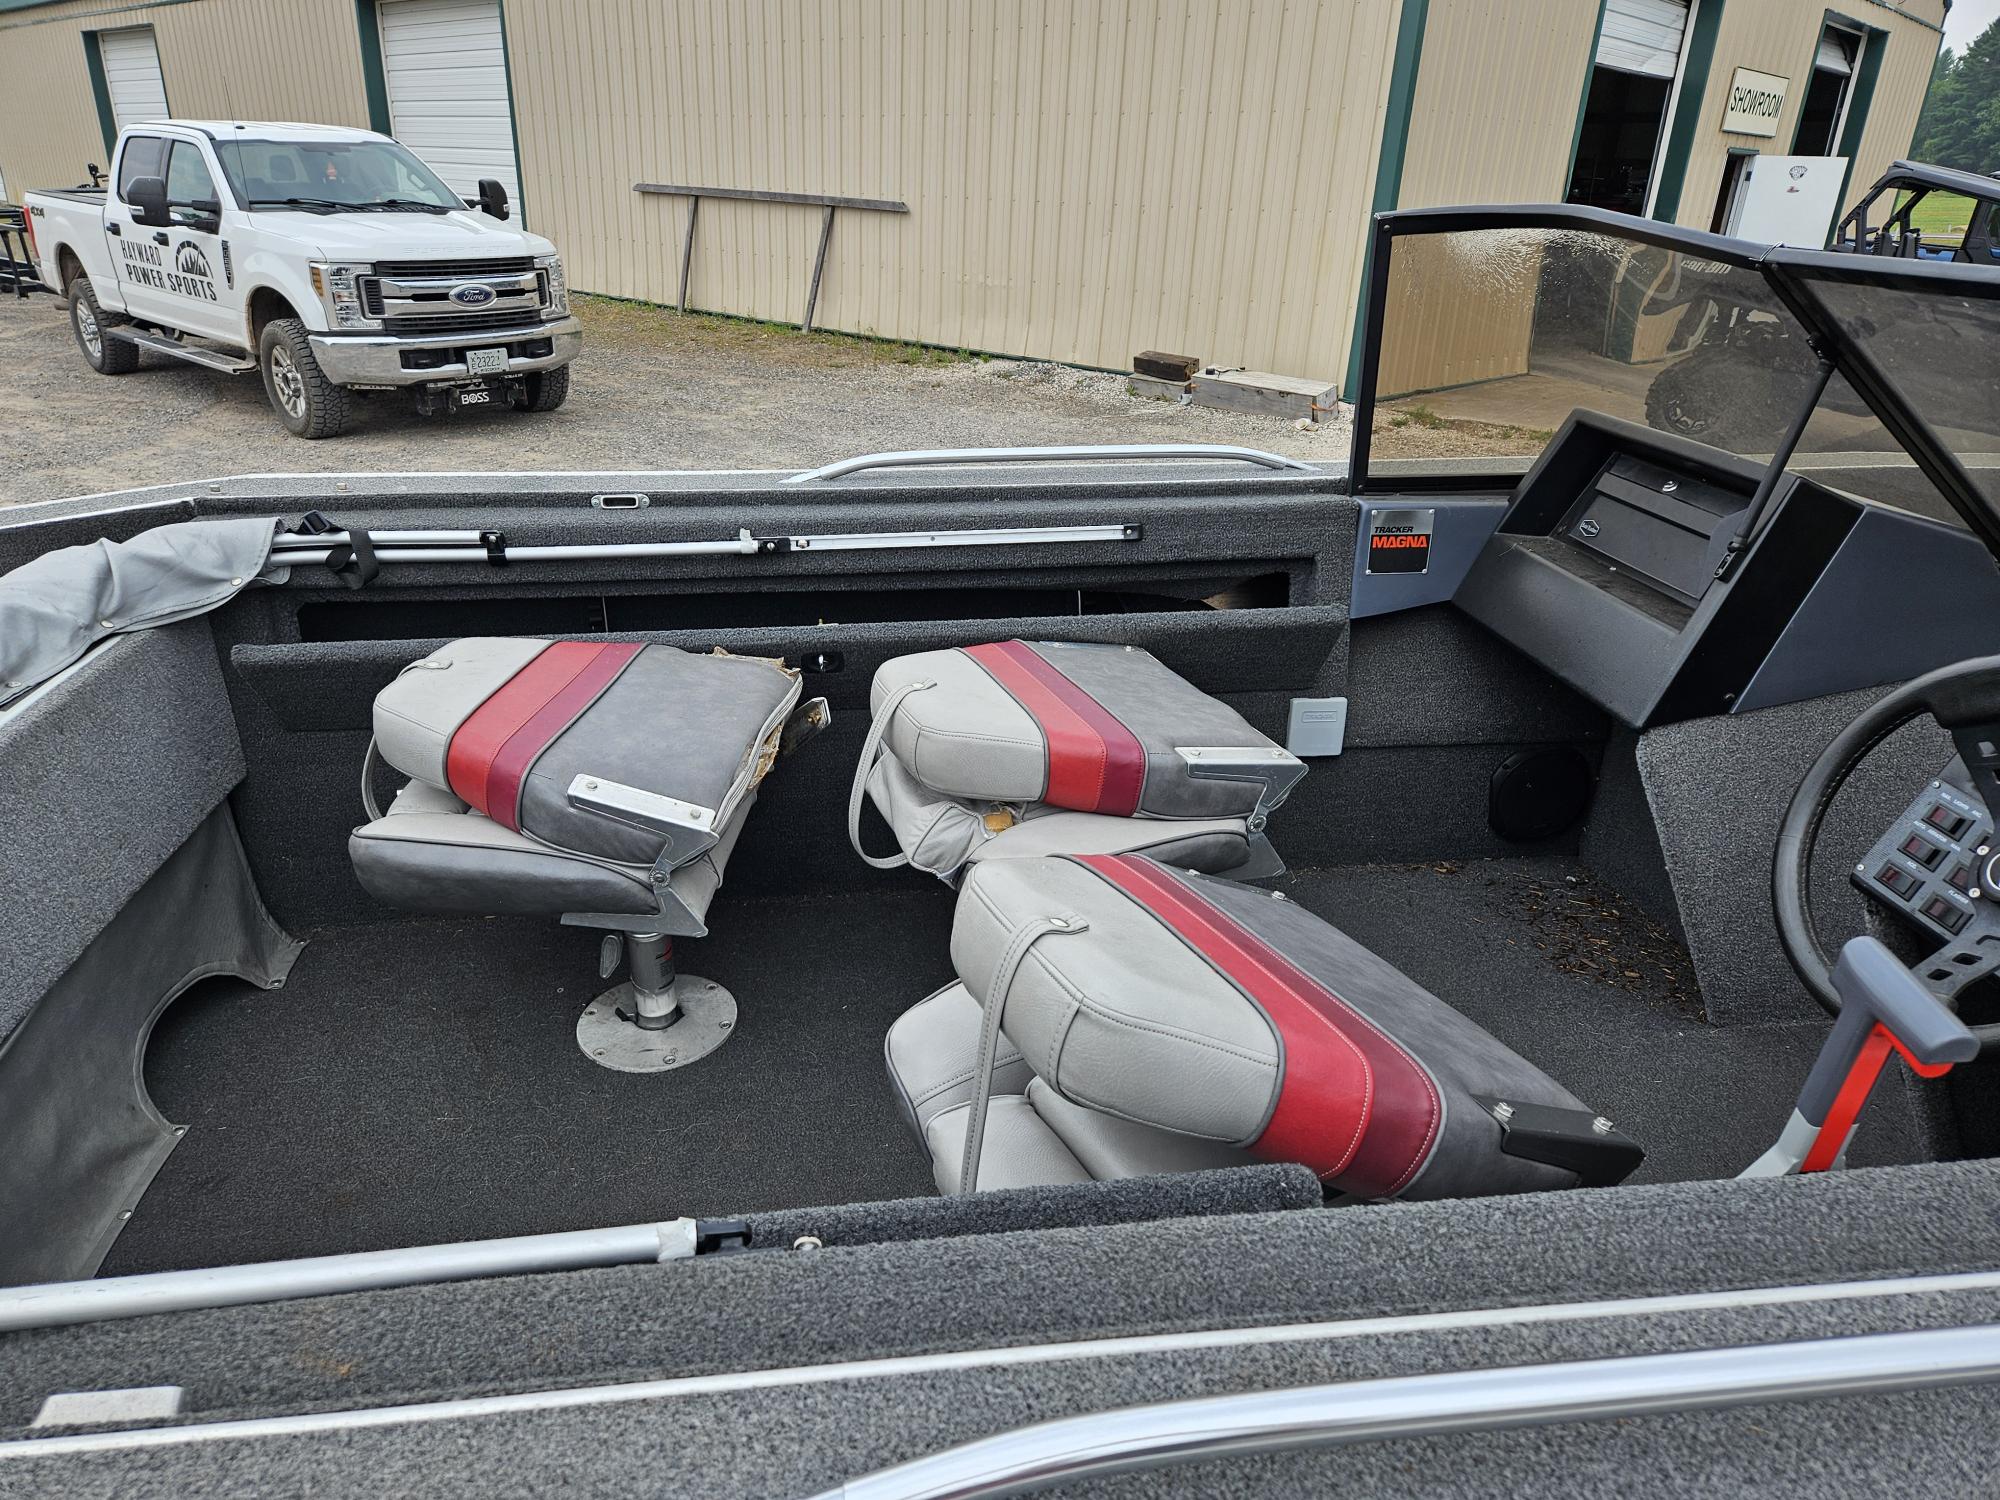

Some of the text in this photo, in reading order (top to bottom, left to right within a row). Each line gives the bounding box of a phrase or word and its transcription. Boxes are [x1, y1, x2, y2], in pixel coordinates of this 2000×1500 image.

[1730, 86, 1784, 119] SHOWROOM
[120, 239, 162, 267] HAYWARD
[125, 263, 217, 301] POWER SPORTS
[463, 289, 486, 301] Ford
[461, 391, 490, 405] BOSS
[1374, 526, 1414, 534] TRACKER
[1372, 535, 1428, 548] MAGNA
